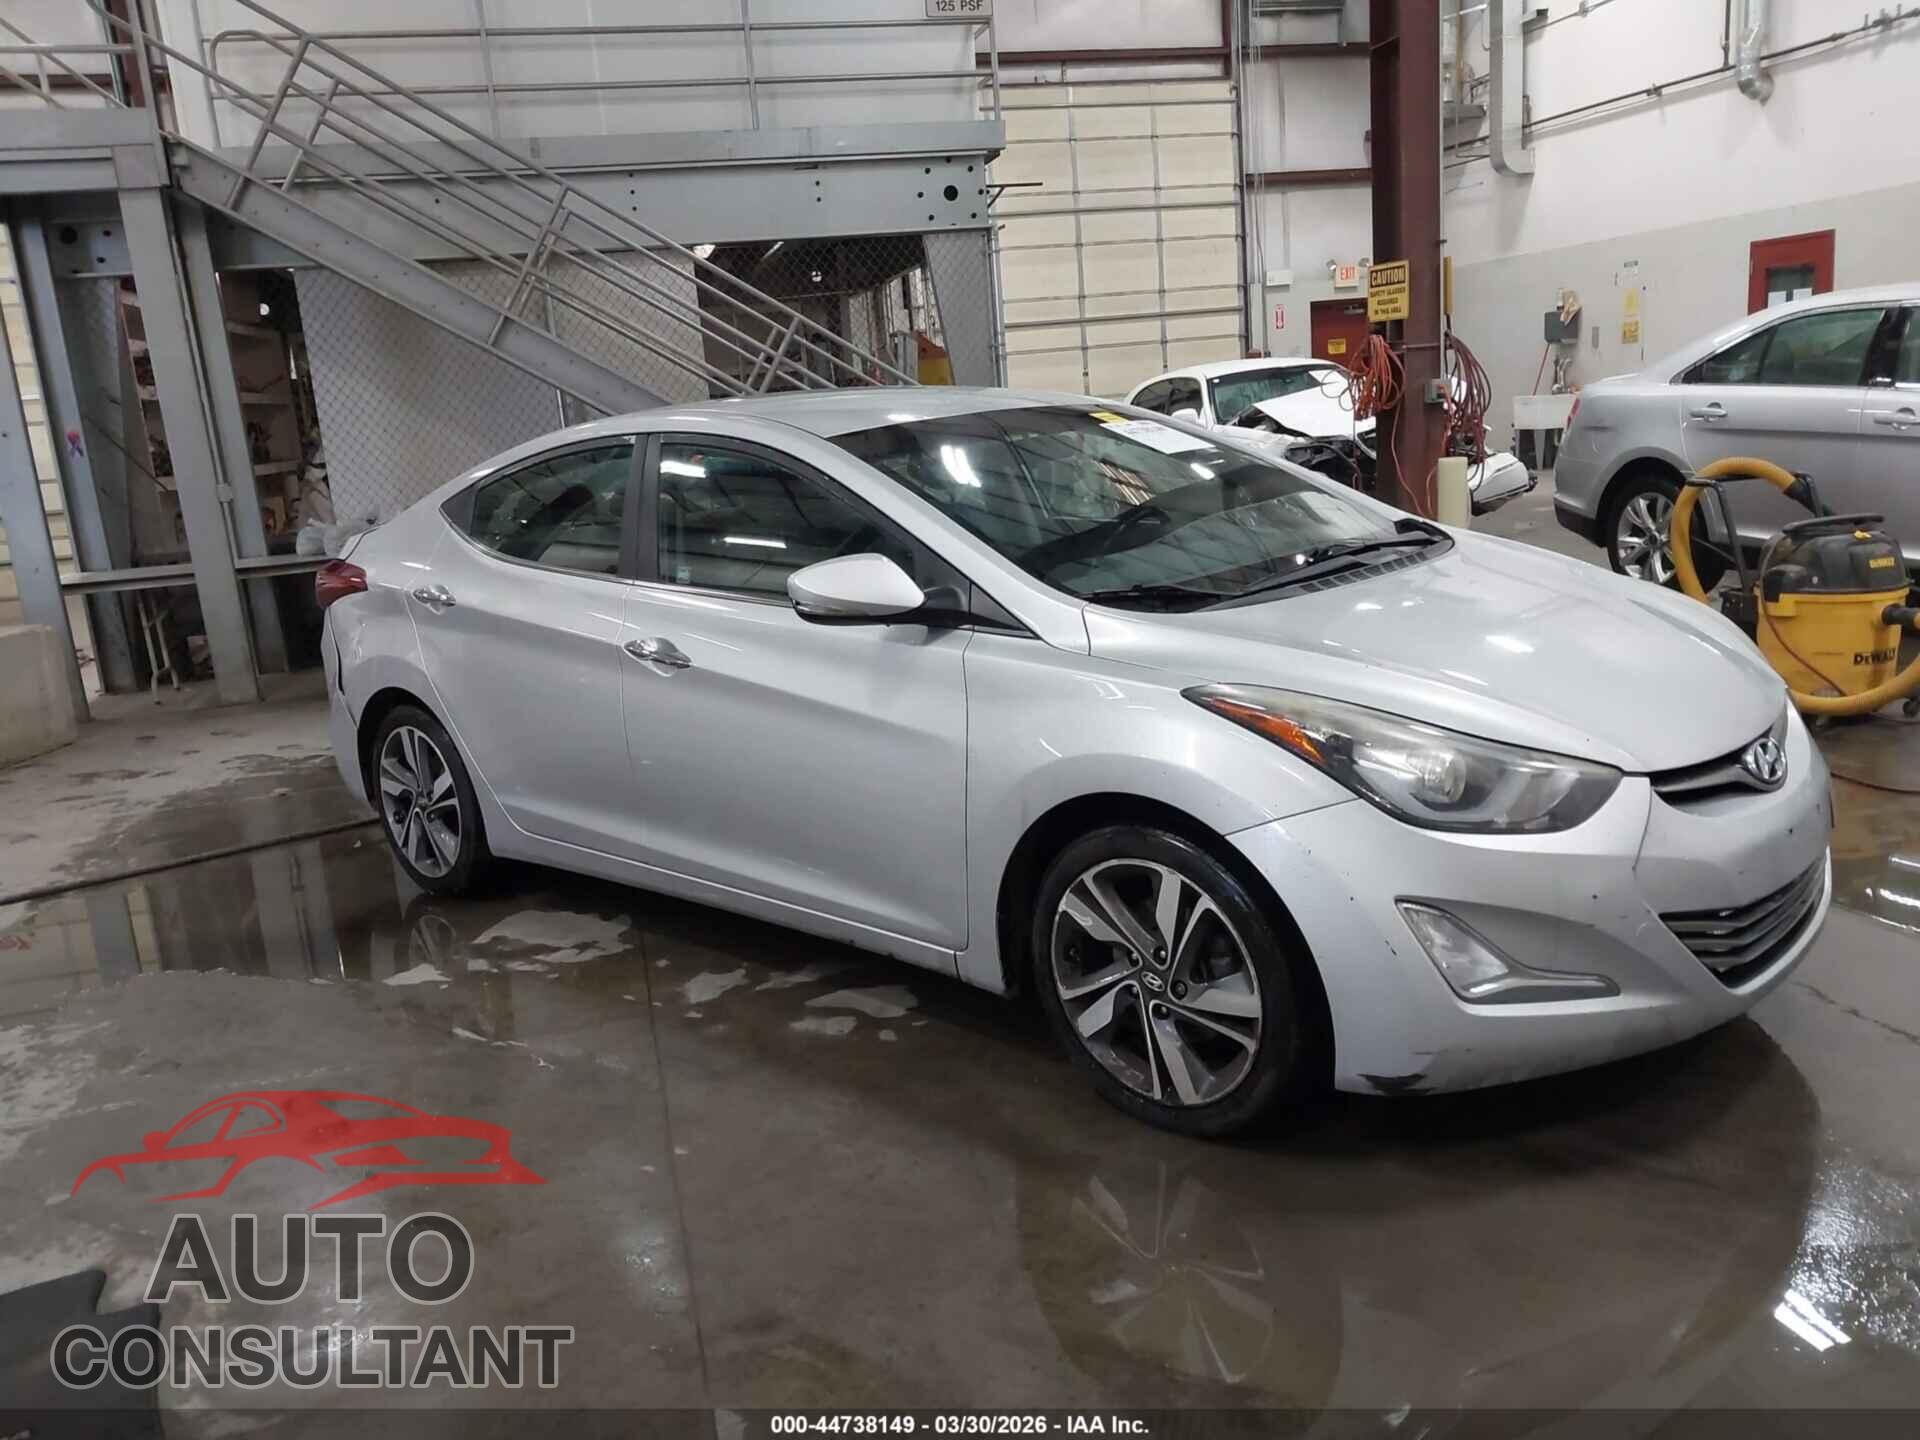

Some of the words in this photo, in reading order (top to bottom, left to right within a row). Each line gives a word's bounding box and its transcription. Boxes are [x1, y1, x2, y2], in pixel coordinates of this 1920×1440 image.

[936, 0, 955, 11] 125
[960, 0, 983, 11] PSF
[1371, 268, 1405, 286] CAUTION
